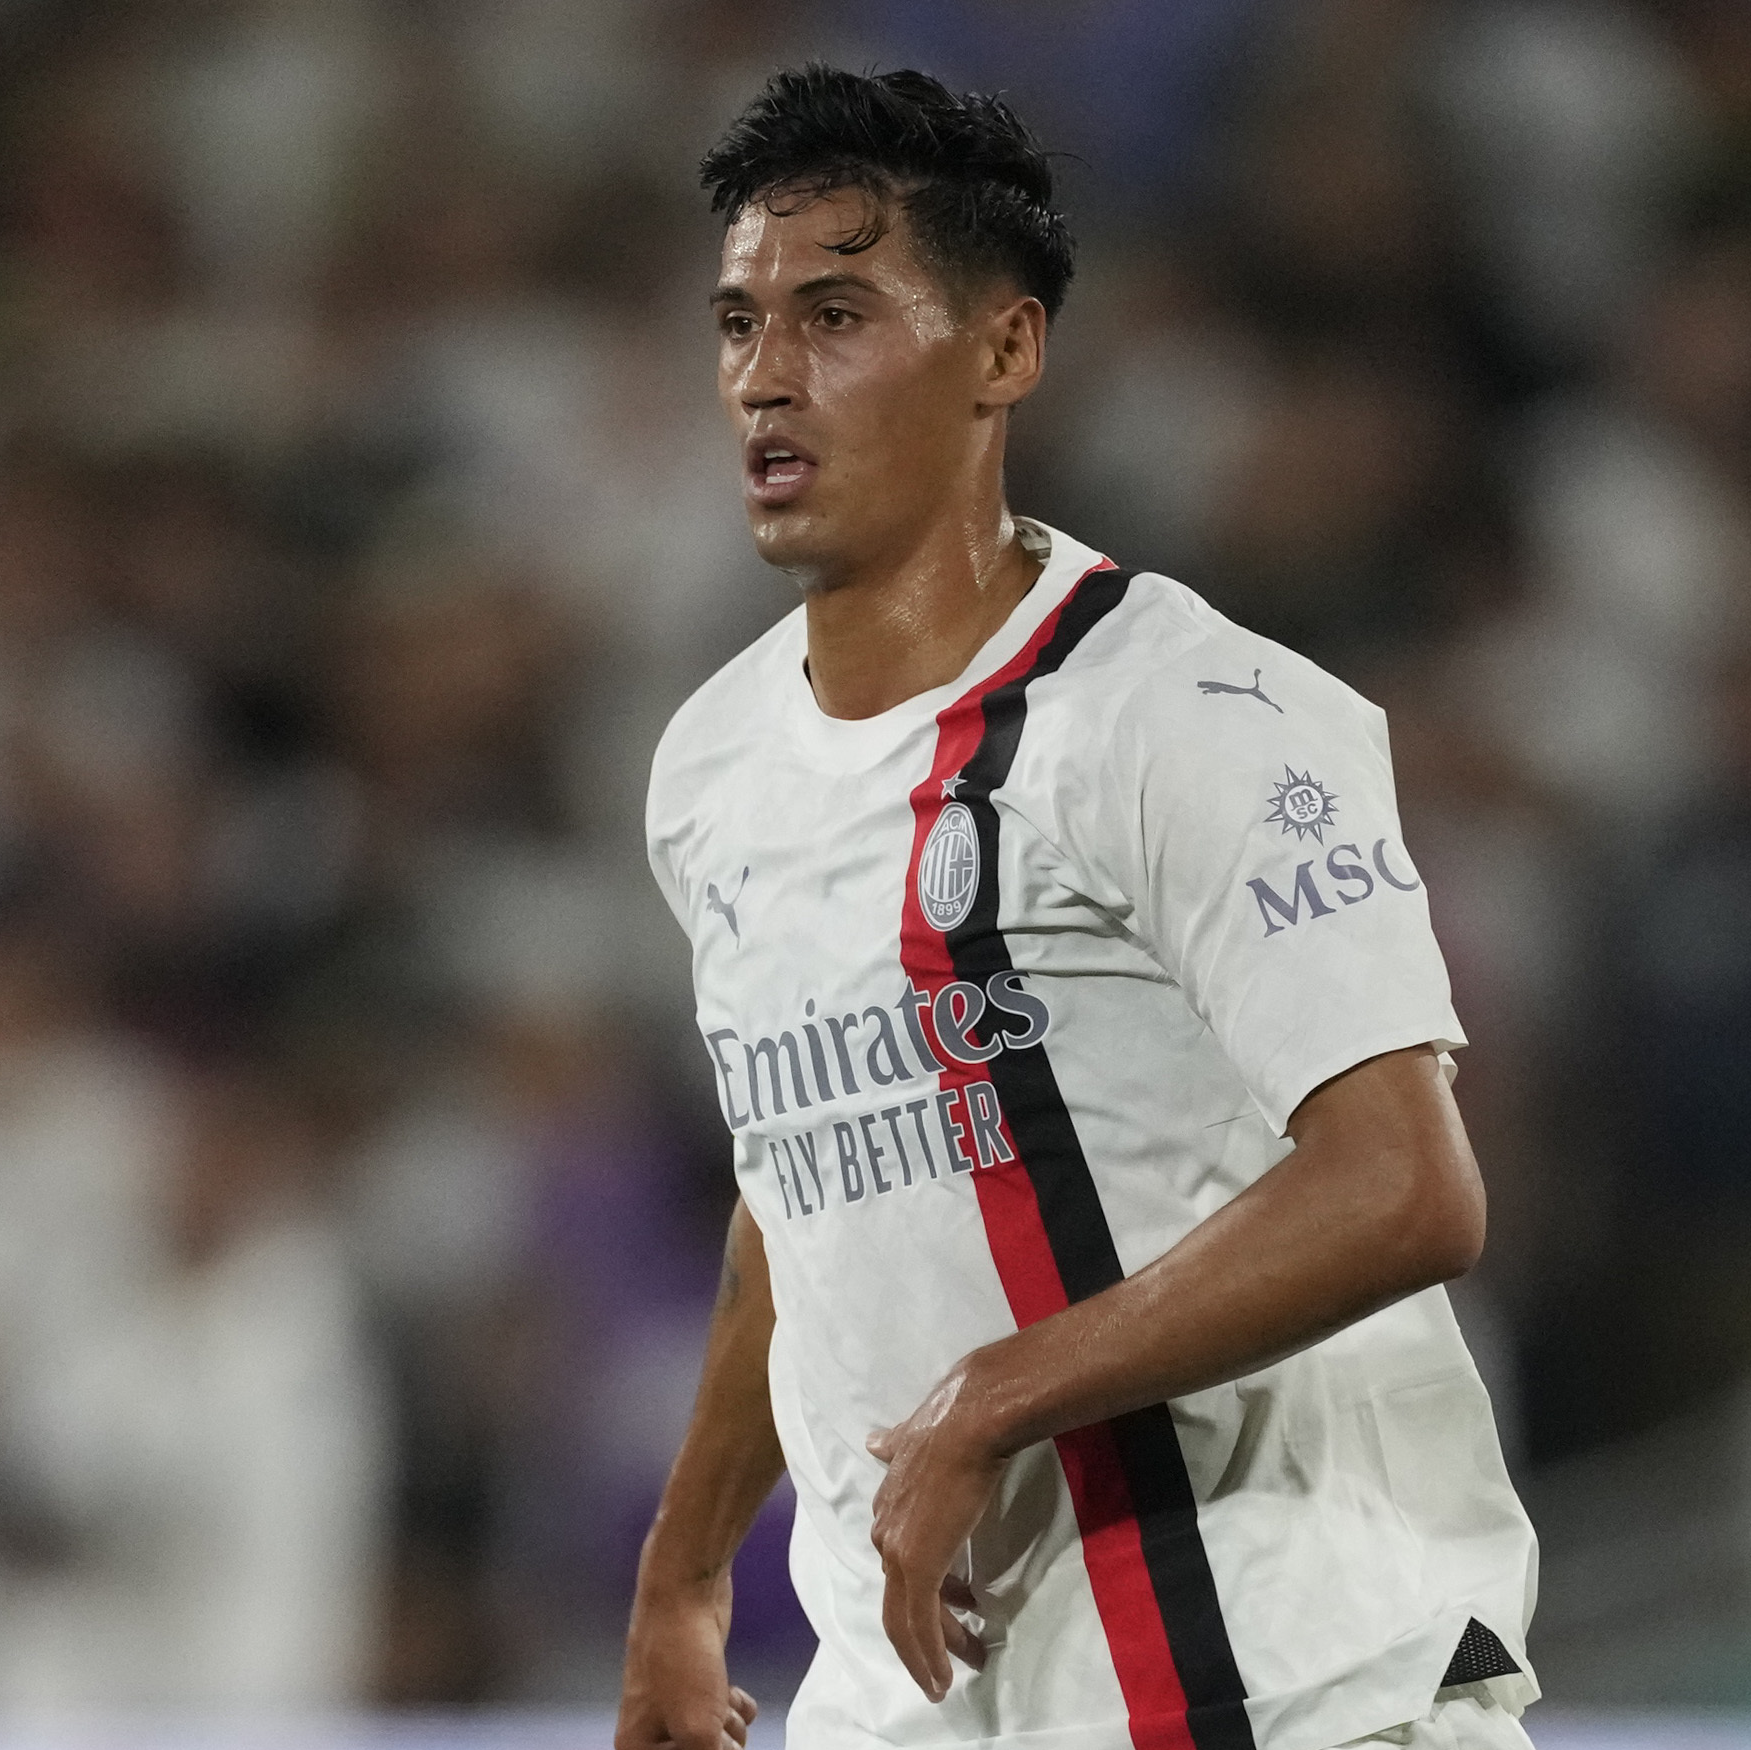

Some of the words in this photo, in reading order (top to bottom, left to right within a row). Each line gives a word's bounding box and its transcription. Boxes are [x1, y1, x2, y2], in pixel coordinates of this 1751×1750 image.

[940, 813, 969, 834] ACM
[931, 900, 963, 917] 1899
[1245, 837, 1421, 939] MSC
[706, 970, 1051, 1131] Emirates
[768, 1130, 826, 1221] FLY
[832, 1080, 1016, 1204] BETTER
